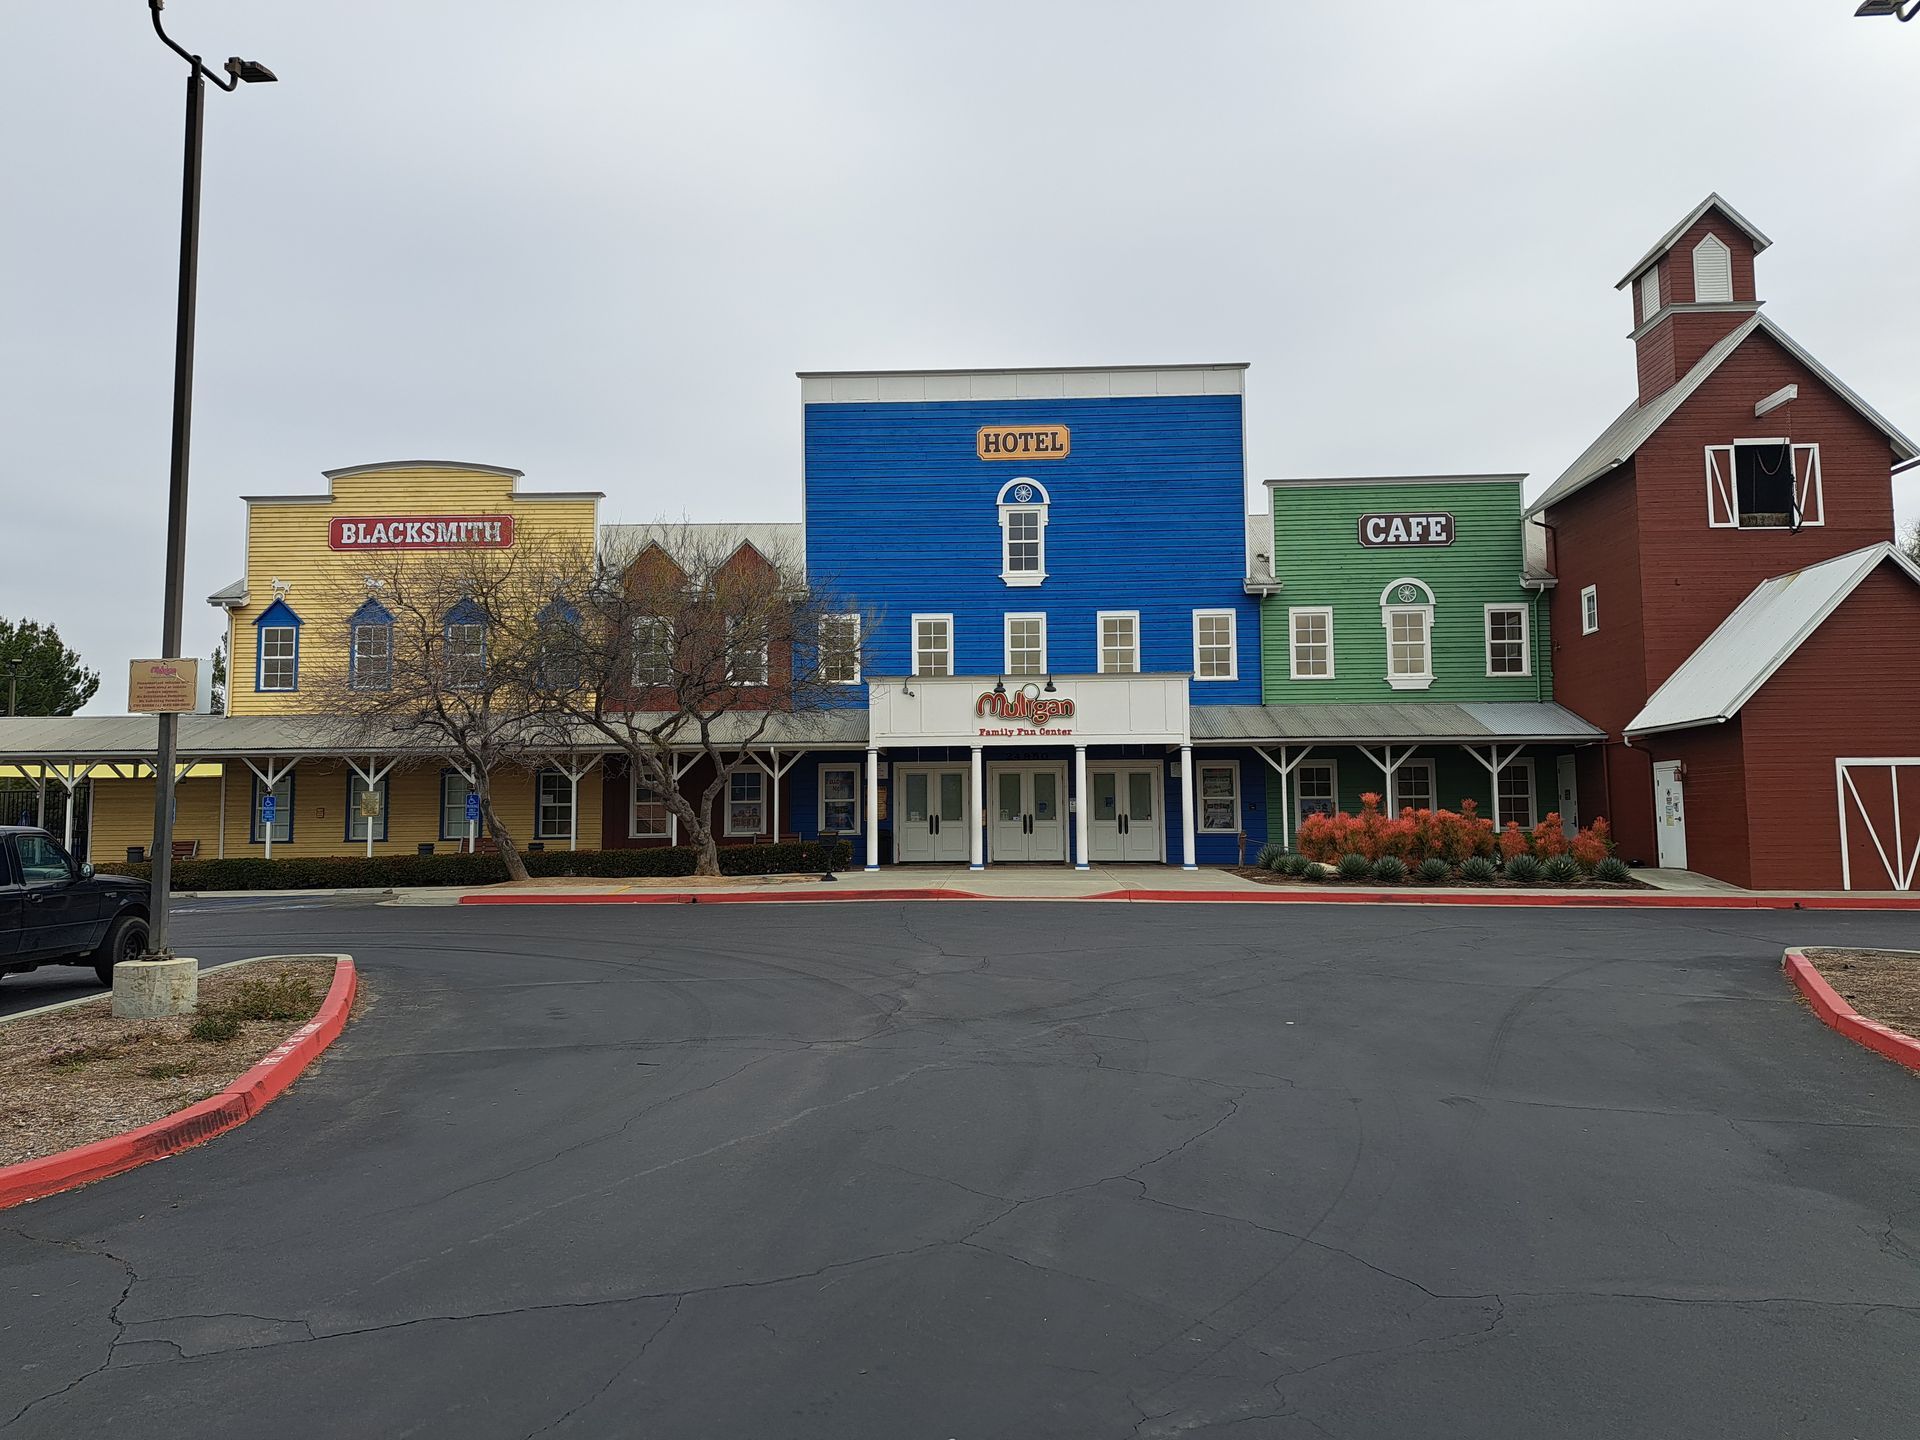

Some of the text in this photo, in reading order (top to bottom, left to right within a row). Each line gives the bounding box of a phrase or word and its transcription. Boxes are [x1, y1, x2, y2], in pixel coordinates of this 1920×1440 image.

[983, 432, 1064, 453] HOTEL
[341, 521, 502, 544] BLACKSMITH
[1366, 516, 1447, 543] CAFE
[977, 684, 1075, 726] Mulligan
[979, 727, 1073, 737] Family Fun Center
